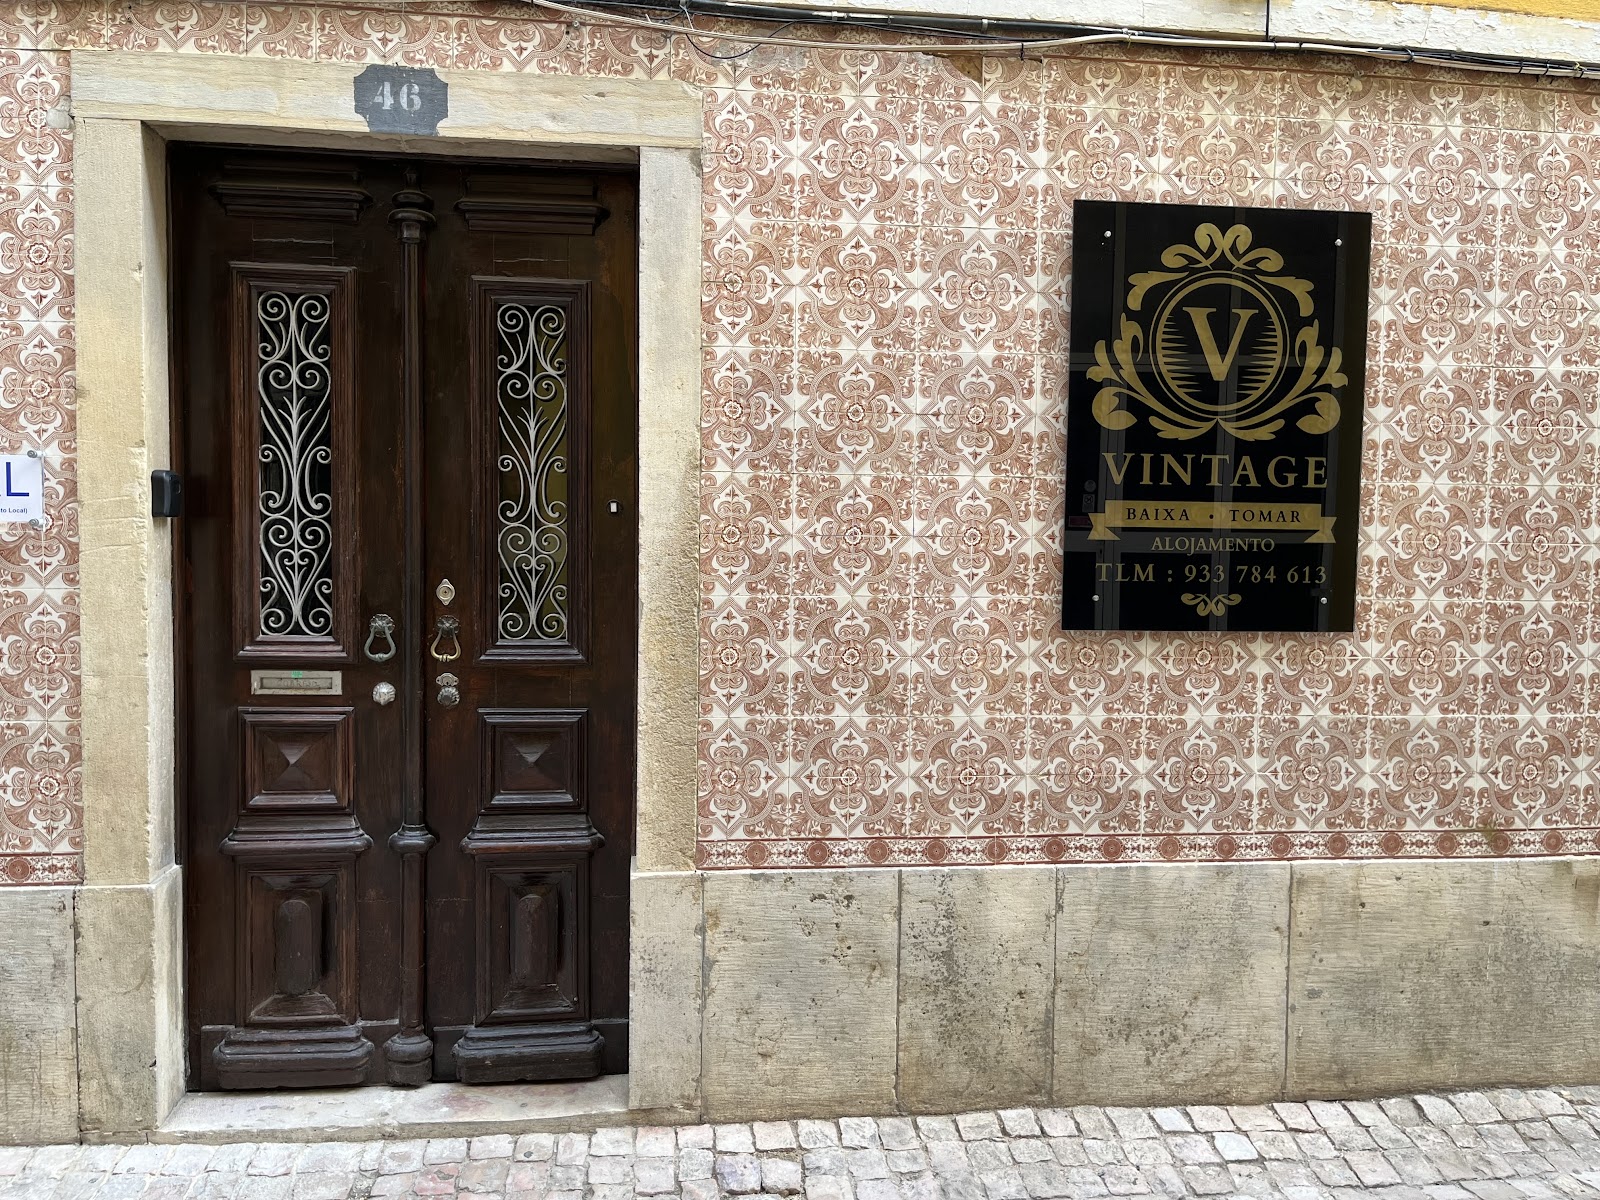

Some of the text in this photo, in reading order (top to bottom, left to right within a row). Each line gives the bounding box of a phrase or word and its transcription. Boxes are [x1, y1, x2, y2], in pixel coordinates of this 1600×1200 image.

[373, 81, 422, 111] 46
[1182, 306, 1259, 382] V
[0, 462, 30, 497] L
[1101, 452, 1328, 488] VINTAGE
[1125, 507, 1190, 522] BAIXA
[1229, 509, 1301, 523] TOMAR
[1150, 536, 1275, 556] ALOJAMENTO
[1095, 562, 1155, 583] TLM
[1184, 564, 1225, 583] 933
[1235, 565, 1277, 584] 784
[1286, 565, 1327, 584] 613
